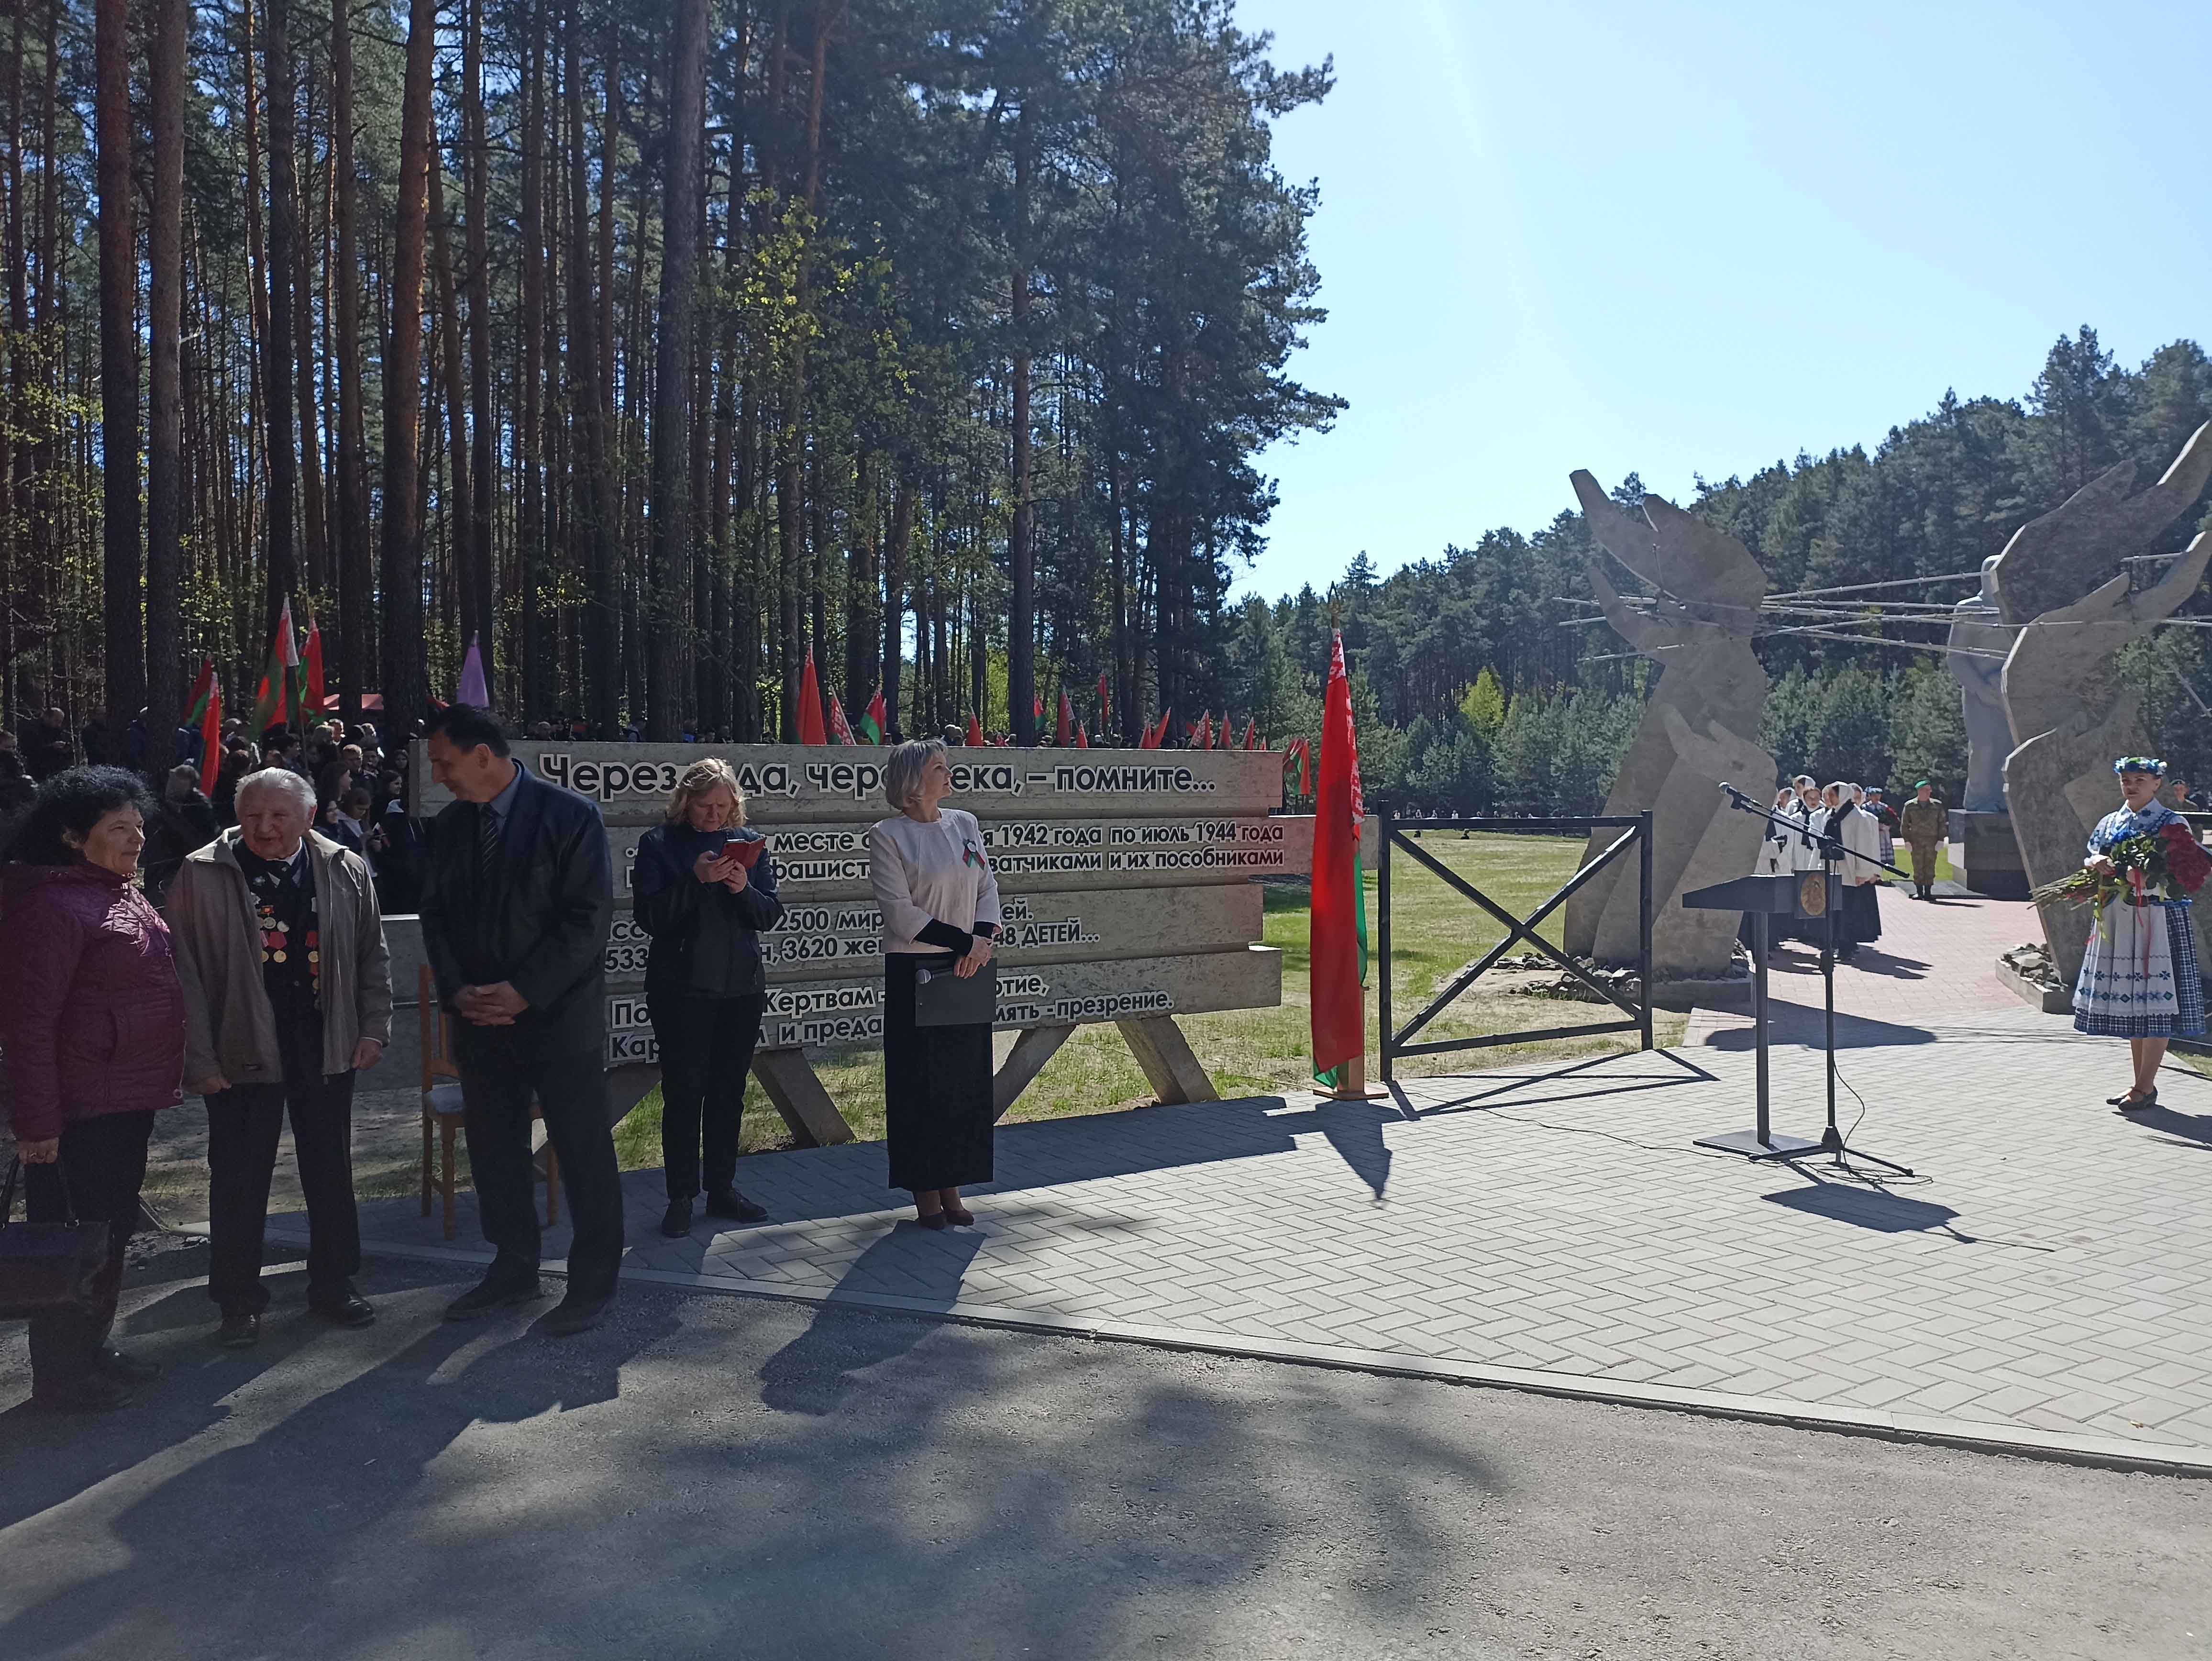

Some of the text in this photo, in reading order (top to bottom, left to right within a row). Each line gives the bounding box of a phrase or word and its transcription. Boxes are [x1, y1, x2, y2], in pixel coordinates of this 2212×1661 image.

[542, 756, 677, 800] Через
[738, 765, 798, 796] да,
[949, 765, 1022, 794] ека,
[1056, 767, 1216, 792] помните...
[773, 833, 855, 852] месте
[1002, 825, 1048, 846] 1942
[1054, 828, 1102, 846] года
[1111, 828, 1136, 843] по
[1141, 827, 1190, 843] июль
[1195, 822, 1237, 842] 1944
[1243, 826, 1284, 843] года
[990, 853, 1102, 872] ватчиками
[1109, 853, 1122, 868] и
[1127, 853, 1150, 867] их
[1155, 847, 1284, 867] пособниками
[783, 936, 838, 960] 3620
[1022, 918, 1100, 946] ДЕТЕЙ...
[781, 1024, 796, 1041] и
